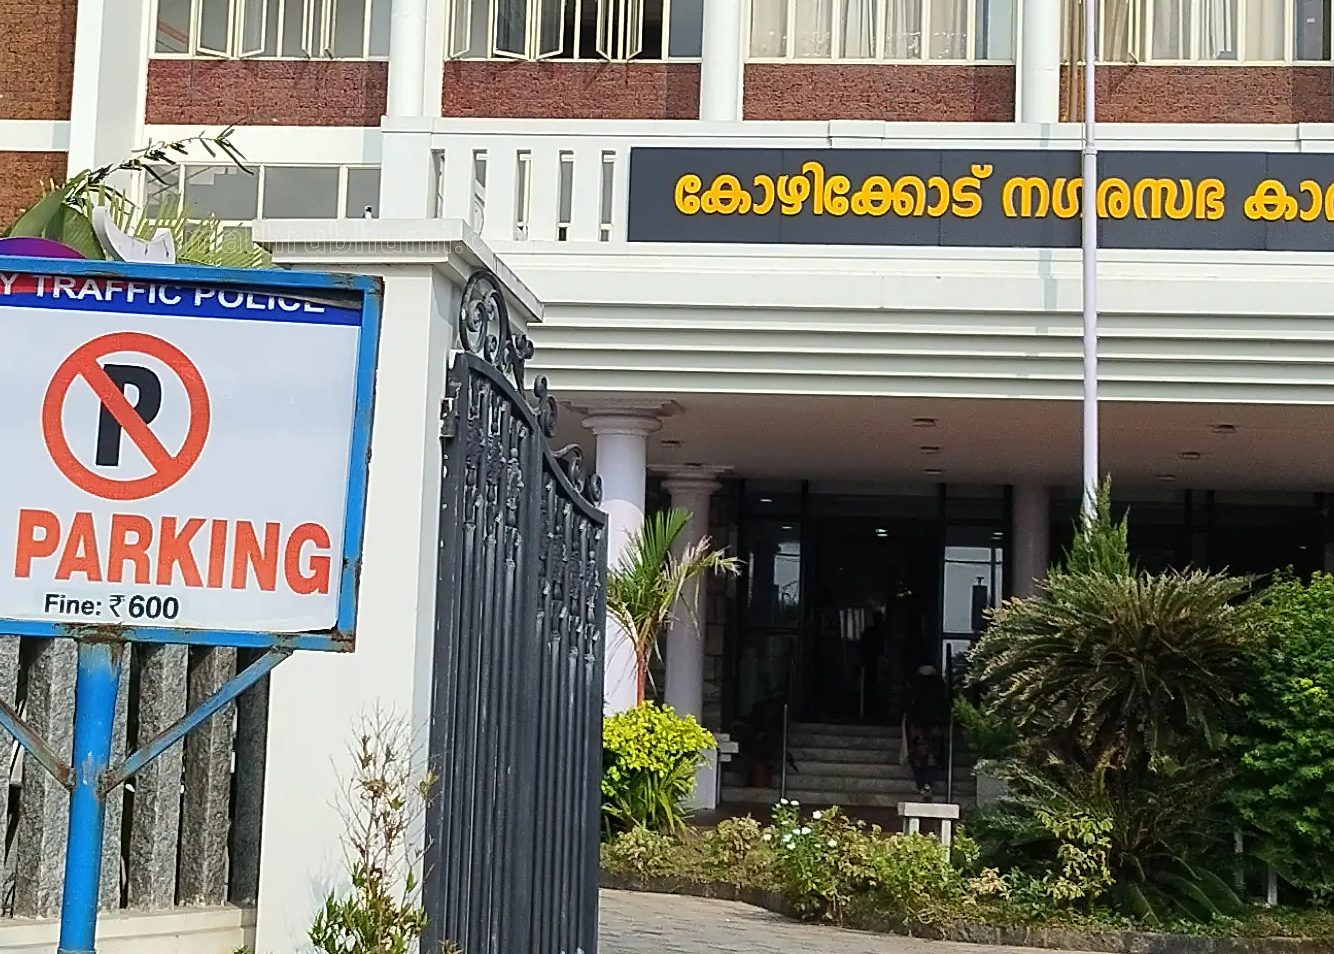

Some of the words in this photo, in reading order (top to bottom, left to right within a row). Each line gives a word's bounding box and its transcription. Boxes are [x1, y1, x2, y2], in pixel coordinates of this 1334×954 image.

[674, 161, 994, 219] കോഴിക്കോട്
[1002, 175, 1225, 220] നഗരസഭ
[31, 274, 182, 305] TRAFFIC
[14, 508, 332, 595] PARKING
[44, 593, 102, 617] Fine:
